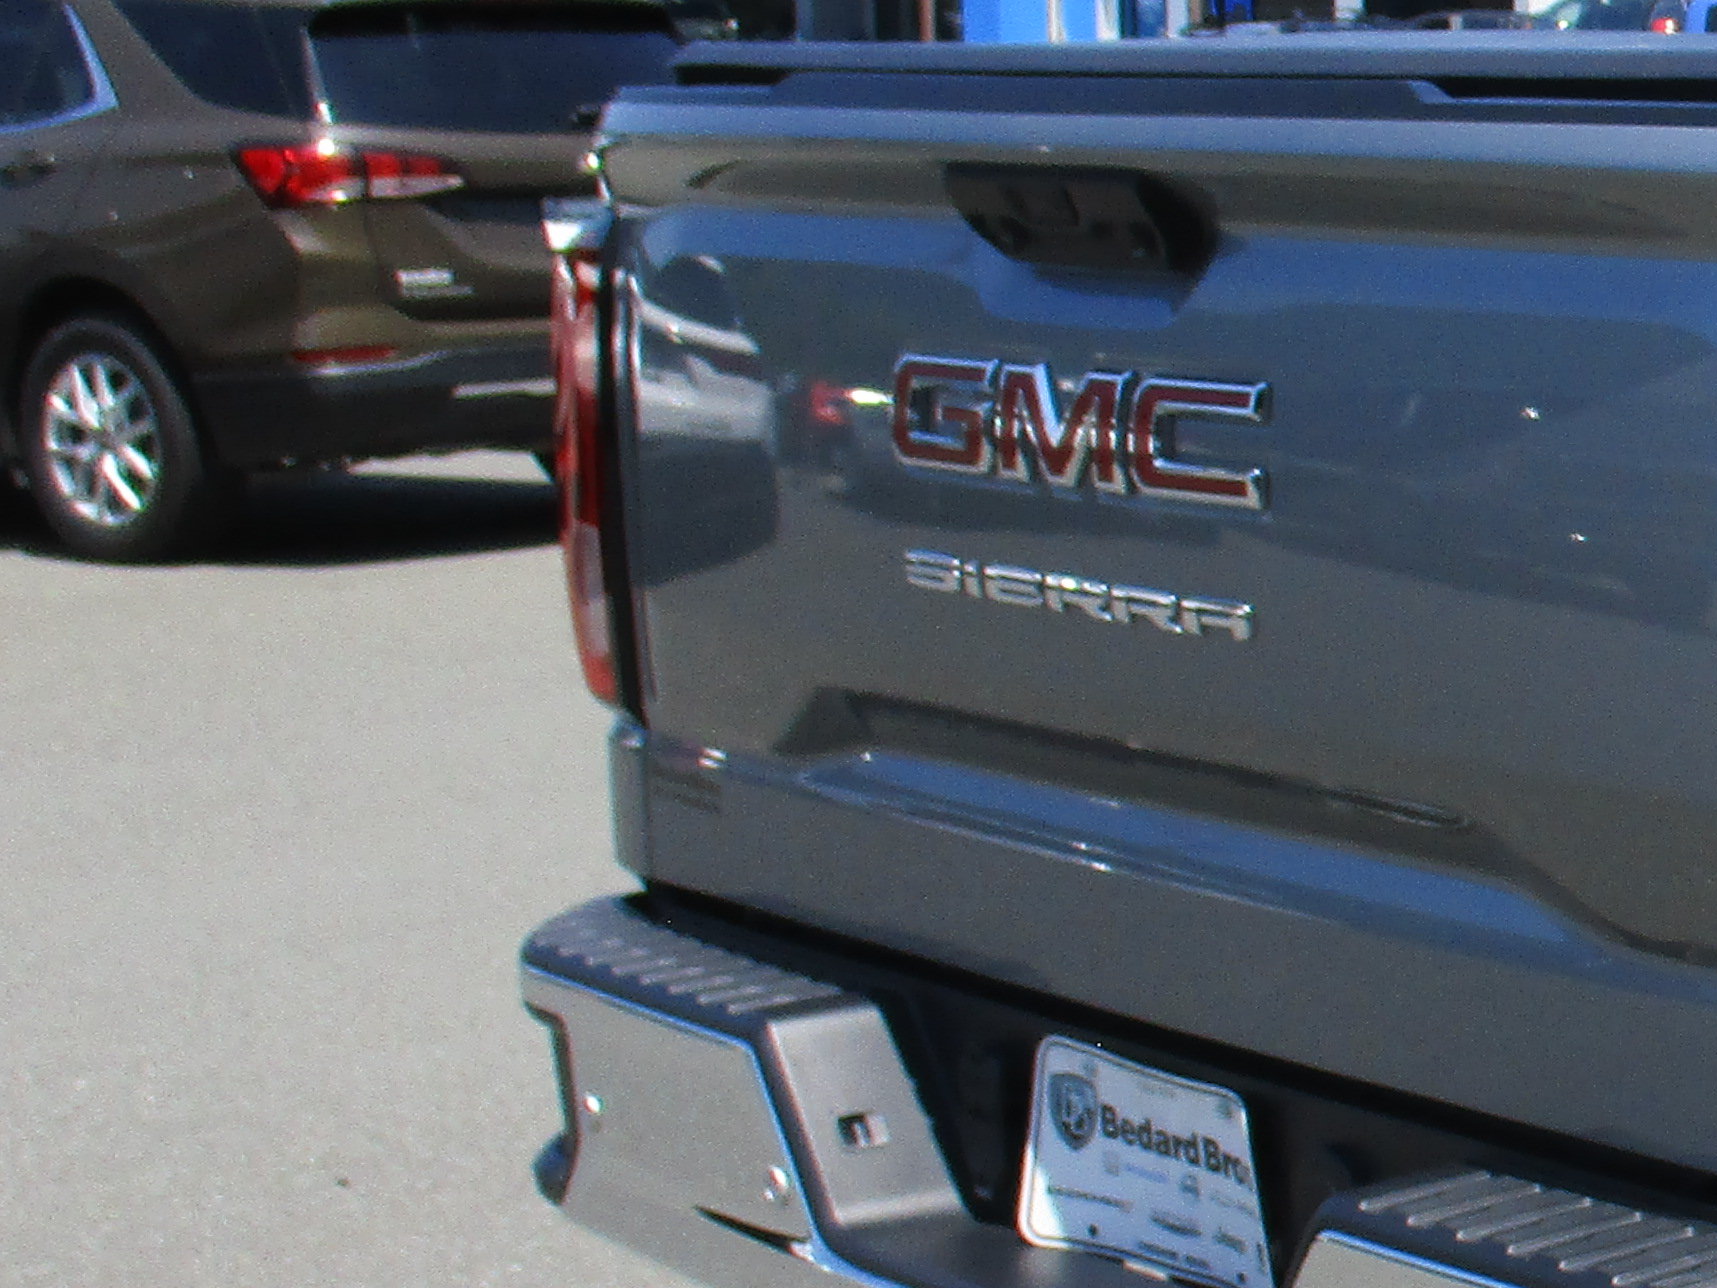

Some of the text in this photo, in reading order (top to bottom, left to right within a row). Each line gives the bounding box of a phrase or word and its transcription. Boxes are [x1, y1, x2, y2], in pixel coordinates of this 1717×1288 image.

[893, 353, 1272, 511] GMC
[905, 549, 1257, 642] SIERRA
[1101, 1102, 1201, 1165] Bedard
